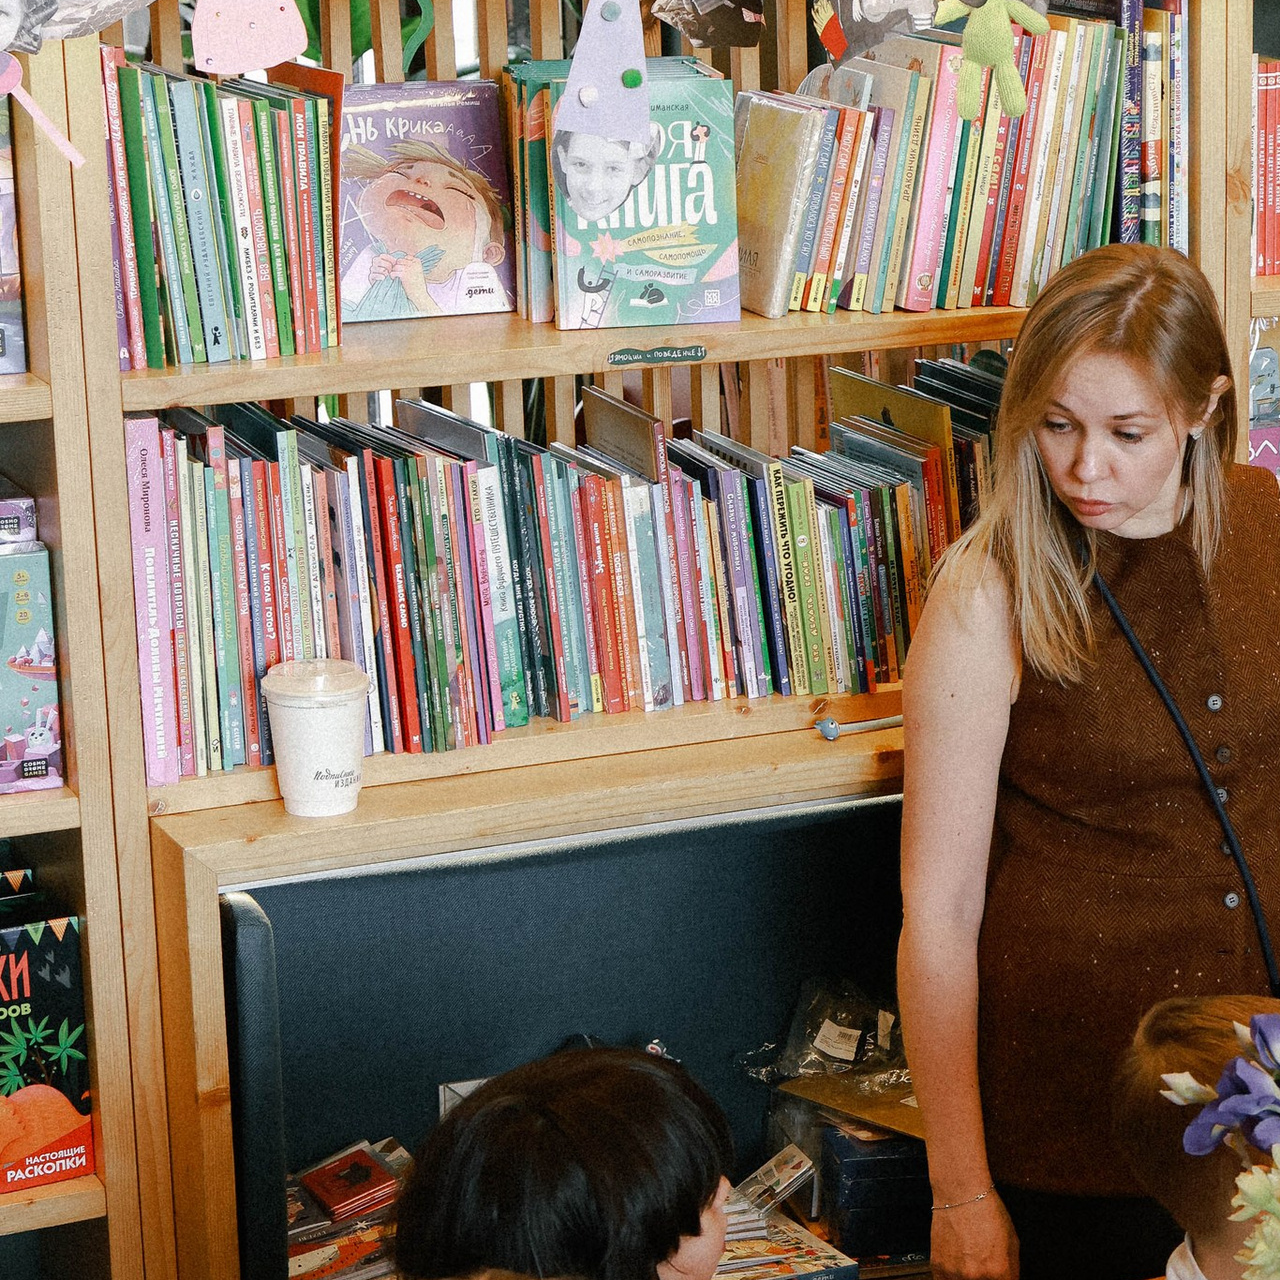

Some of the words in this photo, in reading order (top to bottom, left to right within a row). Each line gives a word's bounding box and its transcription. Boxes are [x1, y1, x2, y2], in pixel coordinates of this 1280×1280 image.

[295, 114, 304, 138] МОИ
[823, 133, 833, 149] МОГУ
[841, 133, 852, 150] МОГУ
[878, 132, 888, 149] МОГУ
[297, 141, 308, 190] ПРАВИЛА
[819, 152, 829, 168] САМ
[838, 153, 848, 169] САМ
[875, 152, 886, 169] САМ
[902, 148, 918, 202] ДРАКОНЧИК
[913, 116, 922, 146] ДЗИНЬ
[832, 192, 840, 202] ЕМ
[871, 192, 879, 201] НЕ
[807, 191, 821, 228] ГОТОВЛЮСЬ
[865, 202, 877, 235] ОБИЖАЮСЬ
[806, 230, 815, 240] КО
[819, 203, 838, 260] САМОСТОЯТЕЛЬНО
[243, 248, 252, 273] ЛИКБЕЗ
[658, 246, 707, 262] САМОПОМОЩЬ
[801, 243, 811, 257] СНУ
[860, 241, 872, 265] ДЕЛЮСЬ
[626, 268, 633, 277] И
[633, 267, 690, 281] САМОРАЗВИТИЕ
[247, 283, 258, 326] РОДИТЕЛЯМИ
[140, 449, 150, 479] Олеся
[773, 469, 783, 488] КАК
[141, 481, 153, 533] Миронова
[485, 485, 502, 554] ПУТЕШЕСТВЕННИКА
[775, 490, 788, 539] ПЕРЕЖИТЬ
[169, 520, 183, 578] НЕСКУЧНЫЕ
[780, 541, 790, 559] ЧТО
[262, 572, 273, 604] ШКОЛЕ
[395, 564, 405, 602] ВЕЖЛИВОЕ
[782, 561, 797, 603] УГОДНО!
[174, 582, 185, 629] ВОПРОСЫ
[512, 560, 520, 582] КОГДА
[516, 601, 525, 632] ГРУСТНО
[264, 606, 276, 639] ГОТОВ?
[398, 604, 408, 628] СЛОВО
[25, 1145, 86, 1166] НАСТОЯЩИЕ
[6, 1154, 87, 1183] РАСКОПКИ
